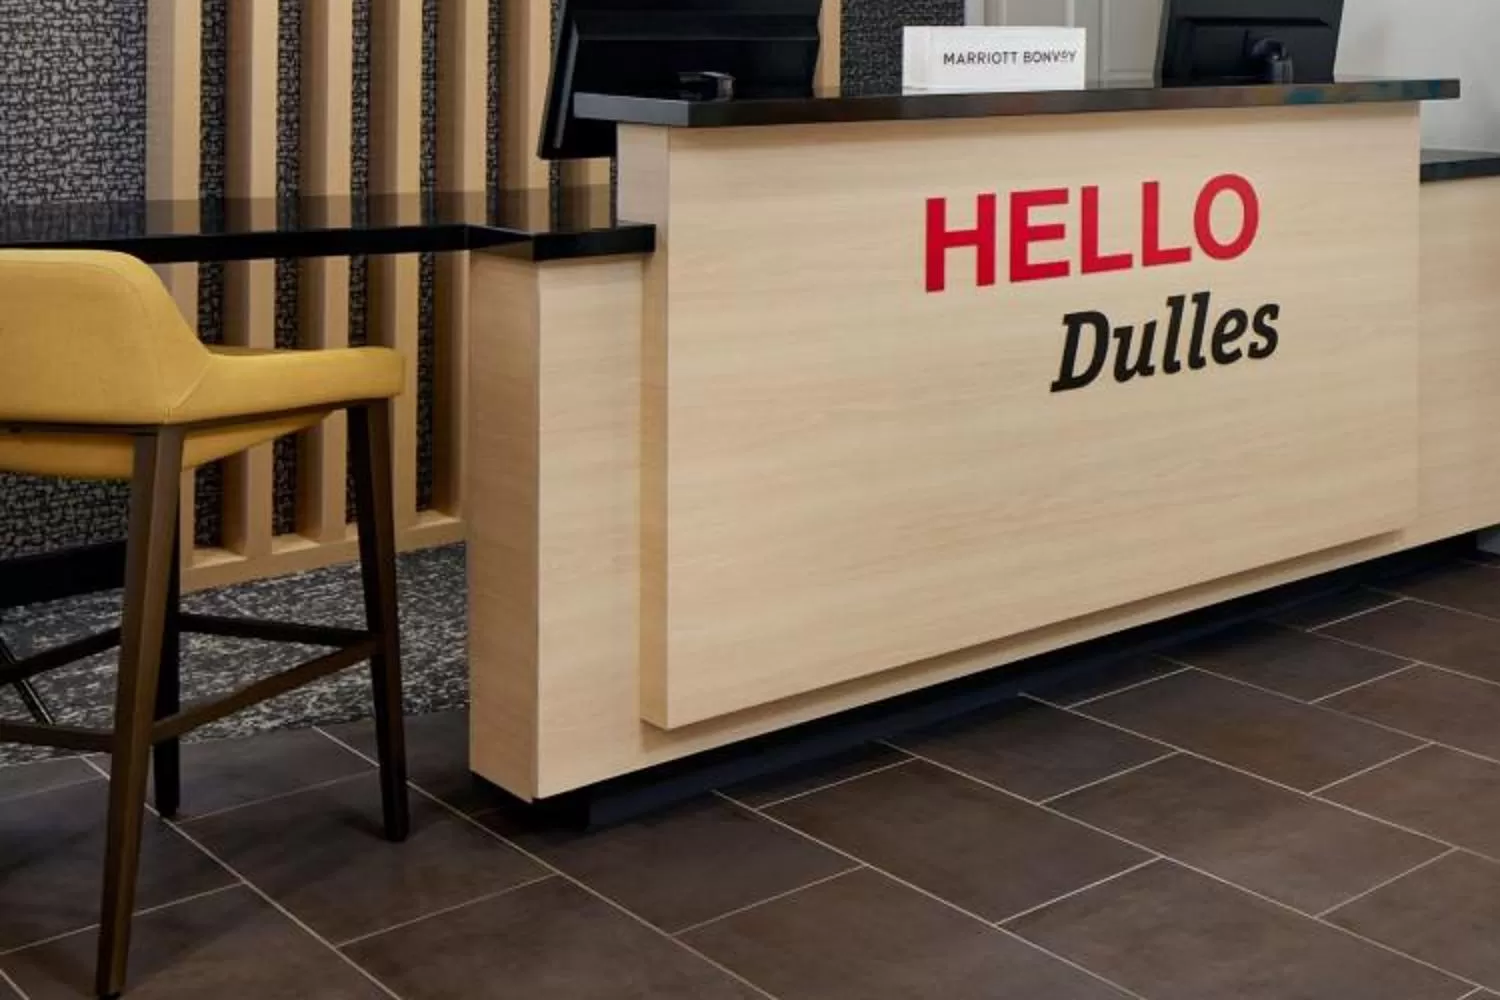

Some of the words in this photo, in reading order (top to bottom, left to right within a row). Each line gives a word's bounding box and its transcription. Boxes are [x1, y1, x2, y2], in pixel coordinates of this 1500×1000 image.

[943, 51, 1018, 65] MARRIOTT
[1023, 50, 1077, 63] BONVOY
[925, 173, 1260, 293] HELLO
[1050, 291, 1280, 393] Dulles
